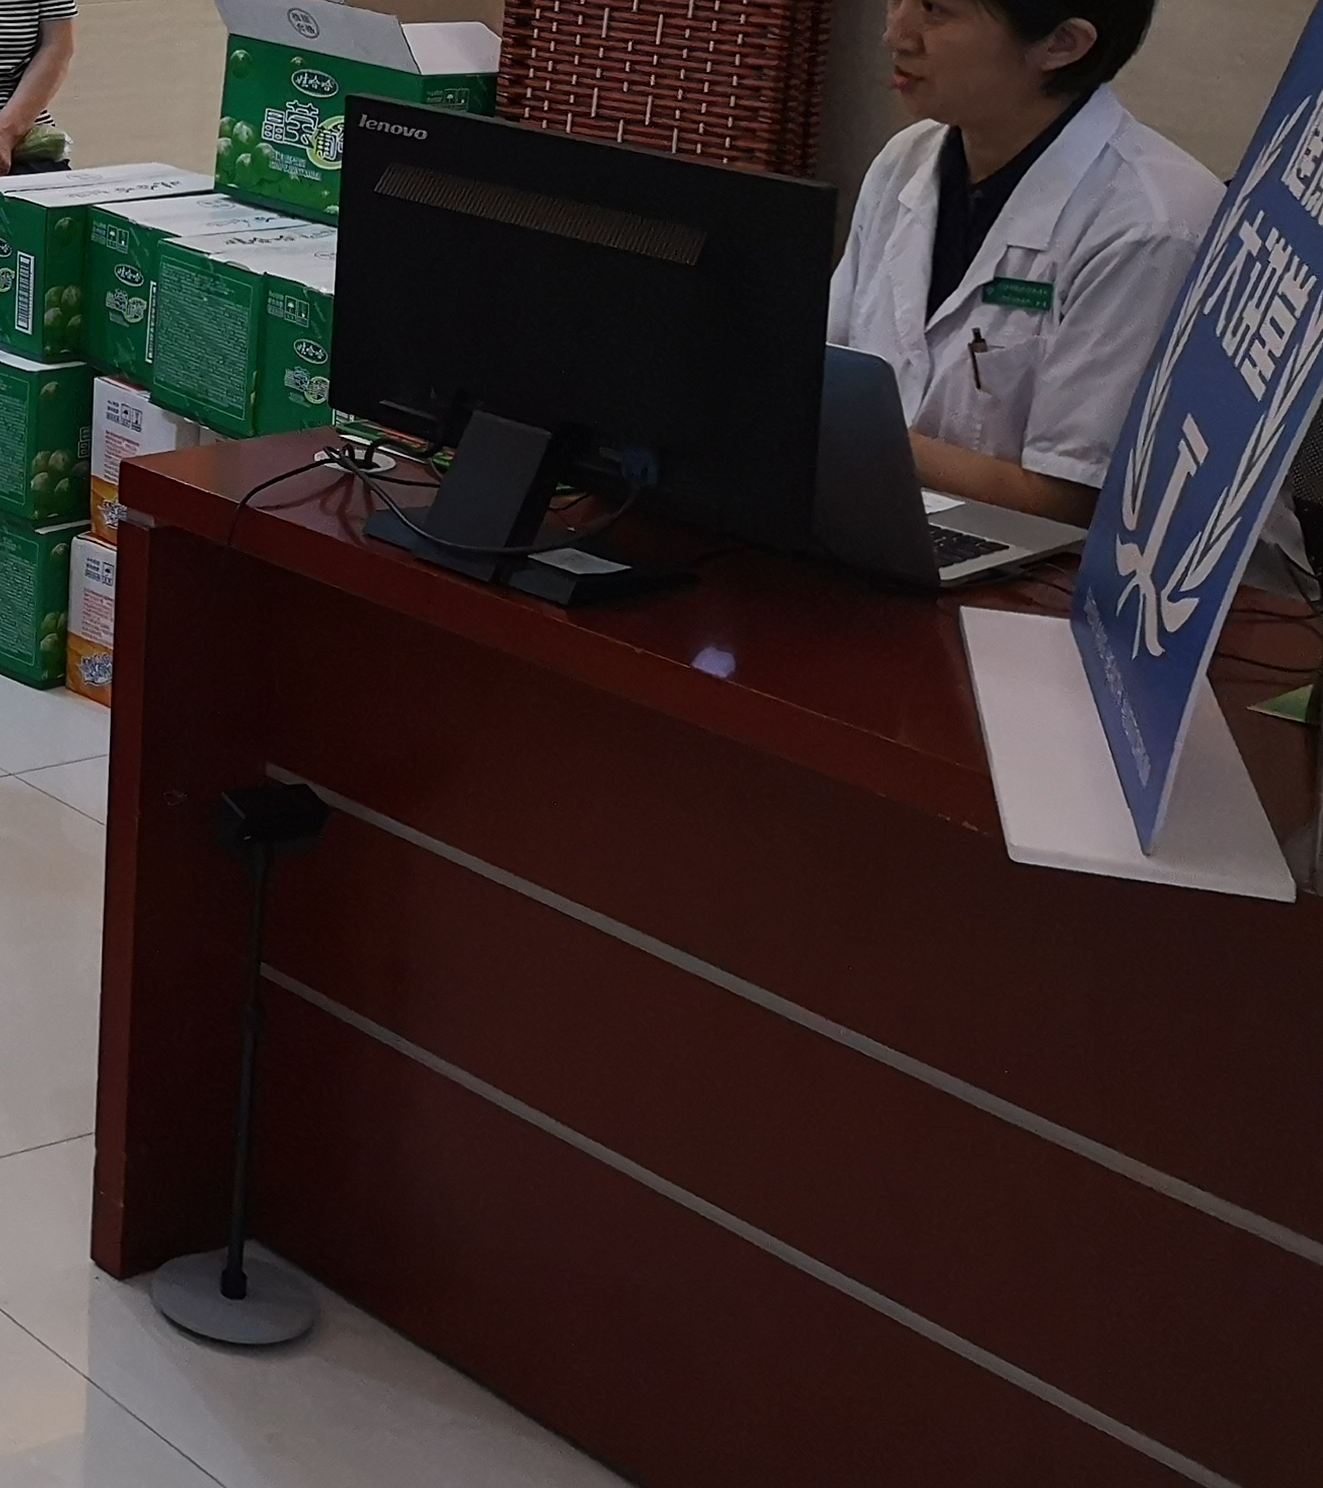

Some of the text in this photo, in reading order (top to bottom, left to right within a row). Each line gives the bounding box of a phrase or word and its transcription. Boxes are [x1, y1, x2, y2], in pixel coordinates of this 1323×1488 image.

[296, 72, 336, 93] 娃哈哈
[358, 113, 429, 141] lenovo
